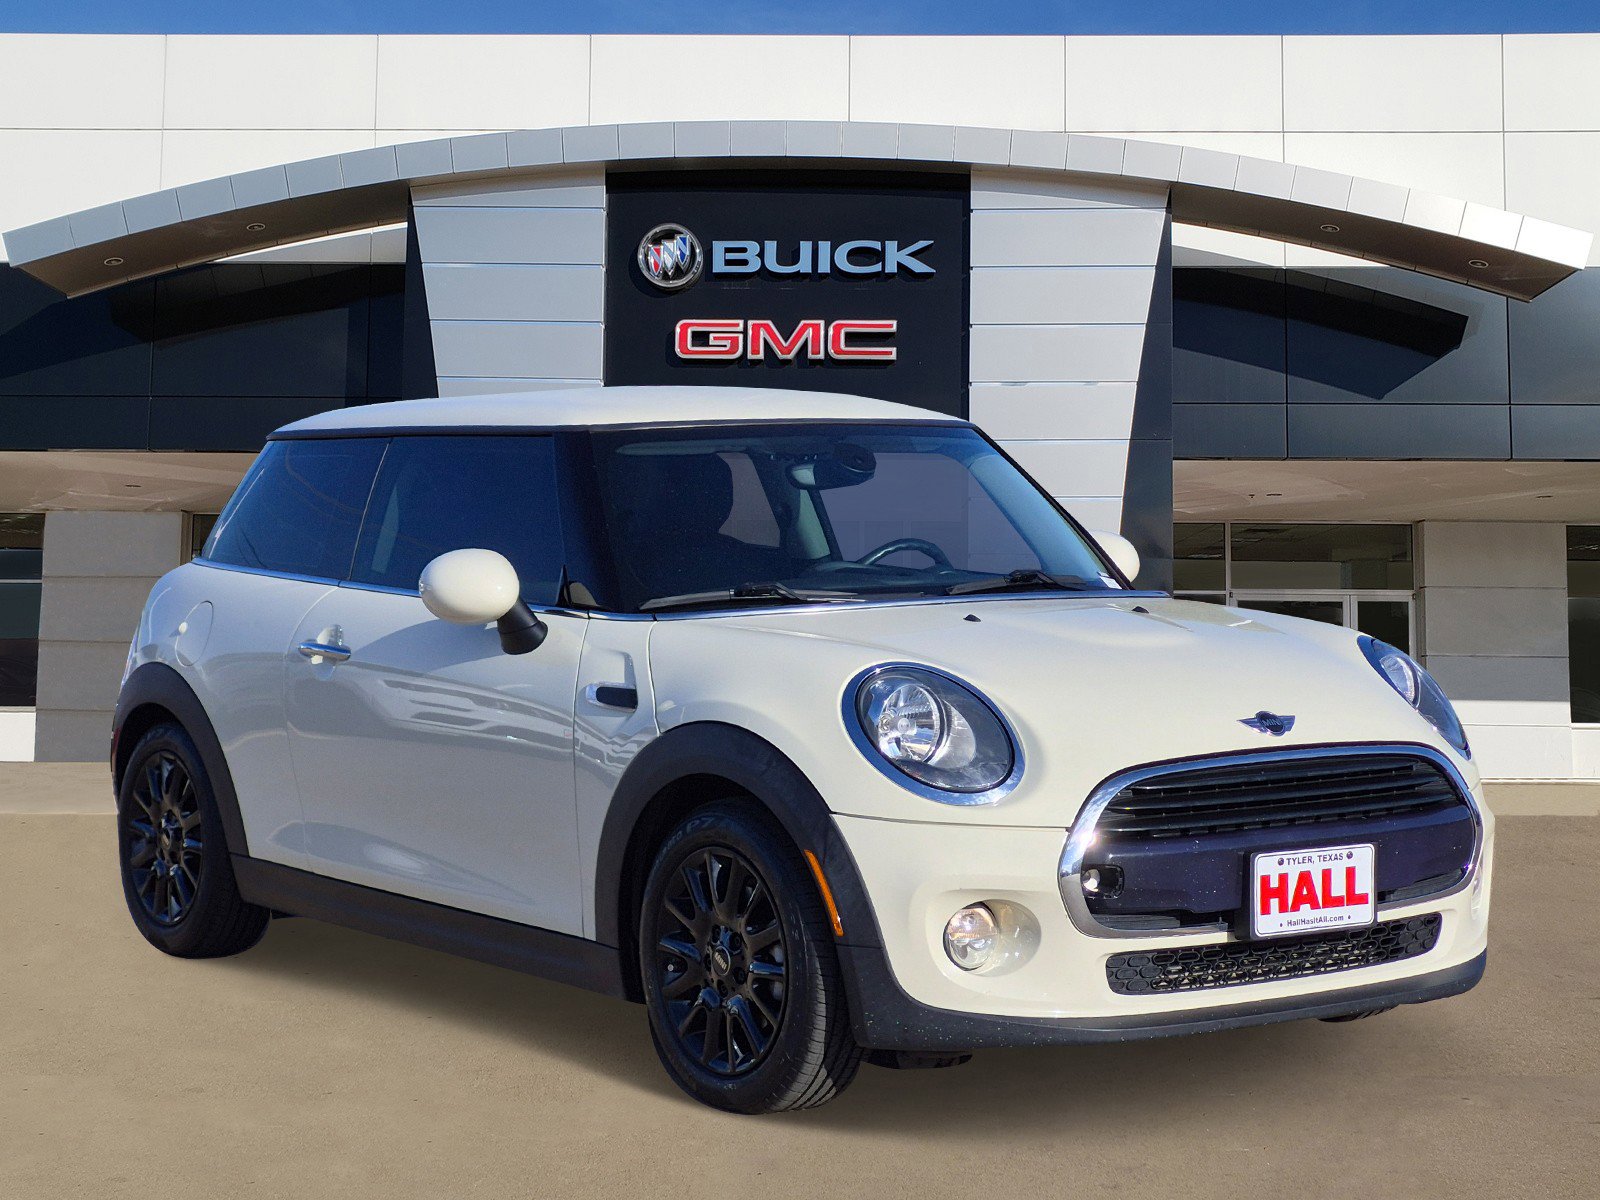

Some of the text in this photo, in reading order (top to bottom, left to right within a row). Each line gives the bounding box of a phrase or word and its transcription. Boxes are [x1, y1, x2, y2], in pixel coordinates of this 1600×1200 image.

[712, 240, 936, 273] BUICK
[675, 319, 897, 360] GMC
[1262, 718, 1282, 726] MINI
[1286, 852, 1344, 866] TYLER, TEXAS
[1260, 866, 1369, 916] HALL
